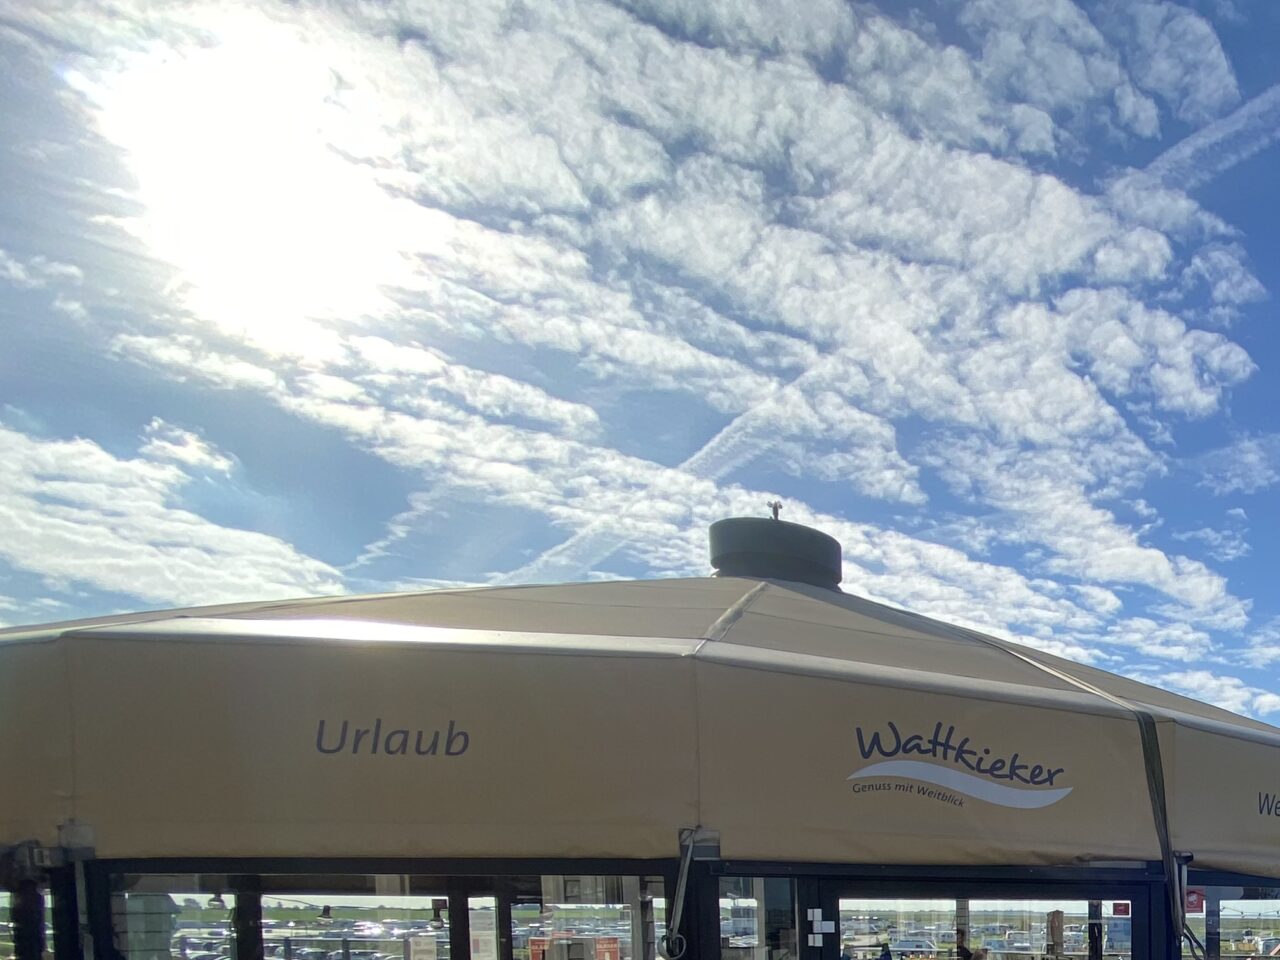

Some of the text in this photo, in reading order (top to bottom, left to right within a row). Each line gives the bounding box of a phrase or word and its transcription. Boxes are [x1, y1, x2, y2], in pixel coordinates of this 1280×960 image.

[316, 718, 470, 756] Urlaub
[855, 721, 1065, 786] Wattkieker
[852, 780, 966, 808] Genuss mit Weitblick
